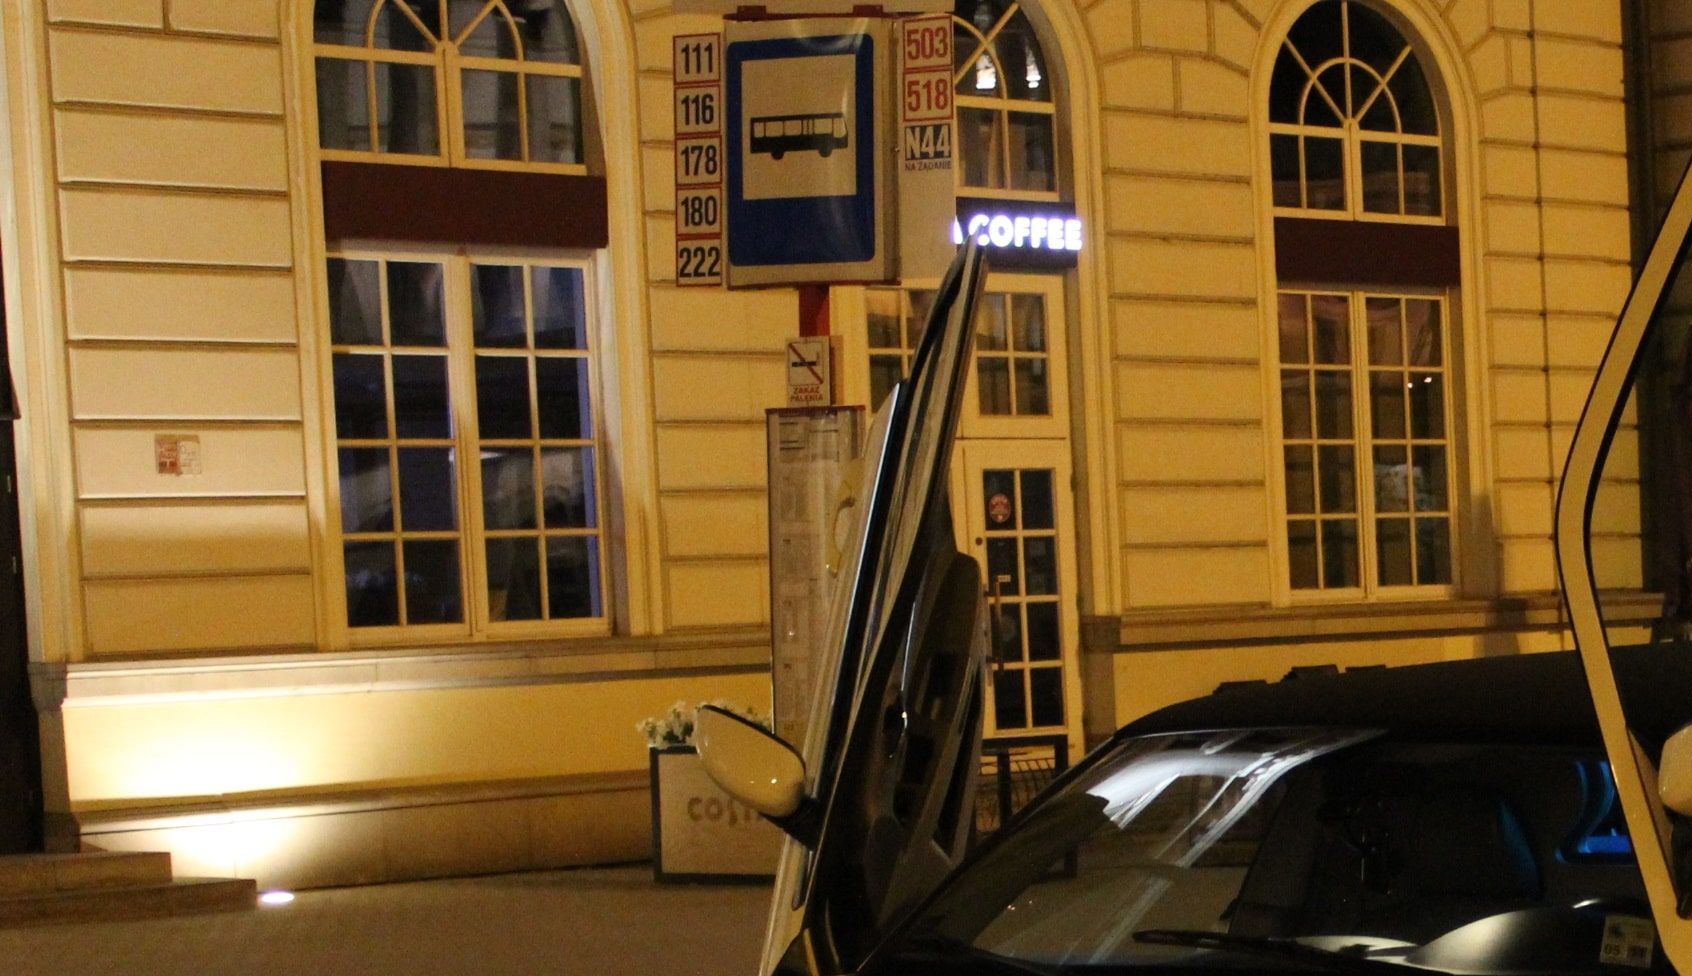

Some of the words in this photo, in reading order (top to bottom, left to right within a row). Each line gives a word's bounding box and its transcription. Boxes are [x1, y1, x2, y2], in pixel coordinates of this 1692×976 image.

[680, 42, 714, 75] 111
[906, 26, 948, 61] 503
[680, 93, 715, 126] 116
[906, 78, 949, 113] 518
[905, 124, 950, 160] N44
[680, 144, 718, 177] 178
[680, 195, 718, 228] 180
[967, 213, 1083, 251] COFFEE
[678, 246, 721, 279] 222
